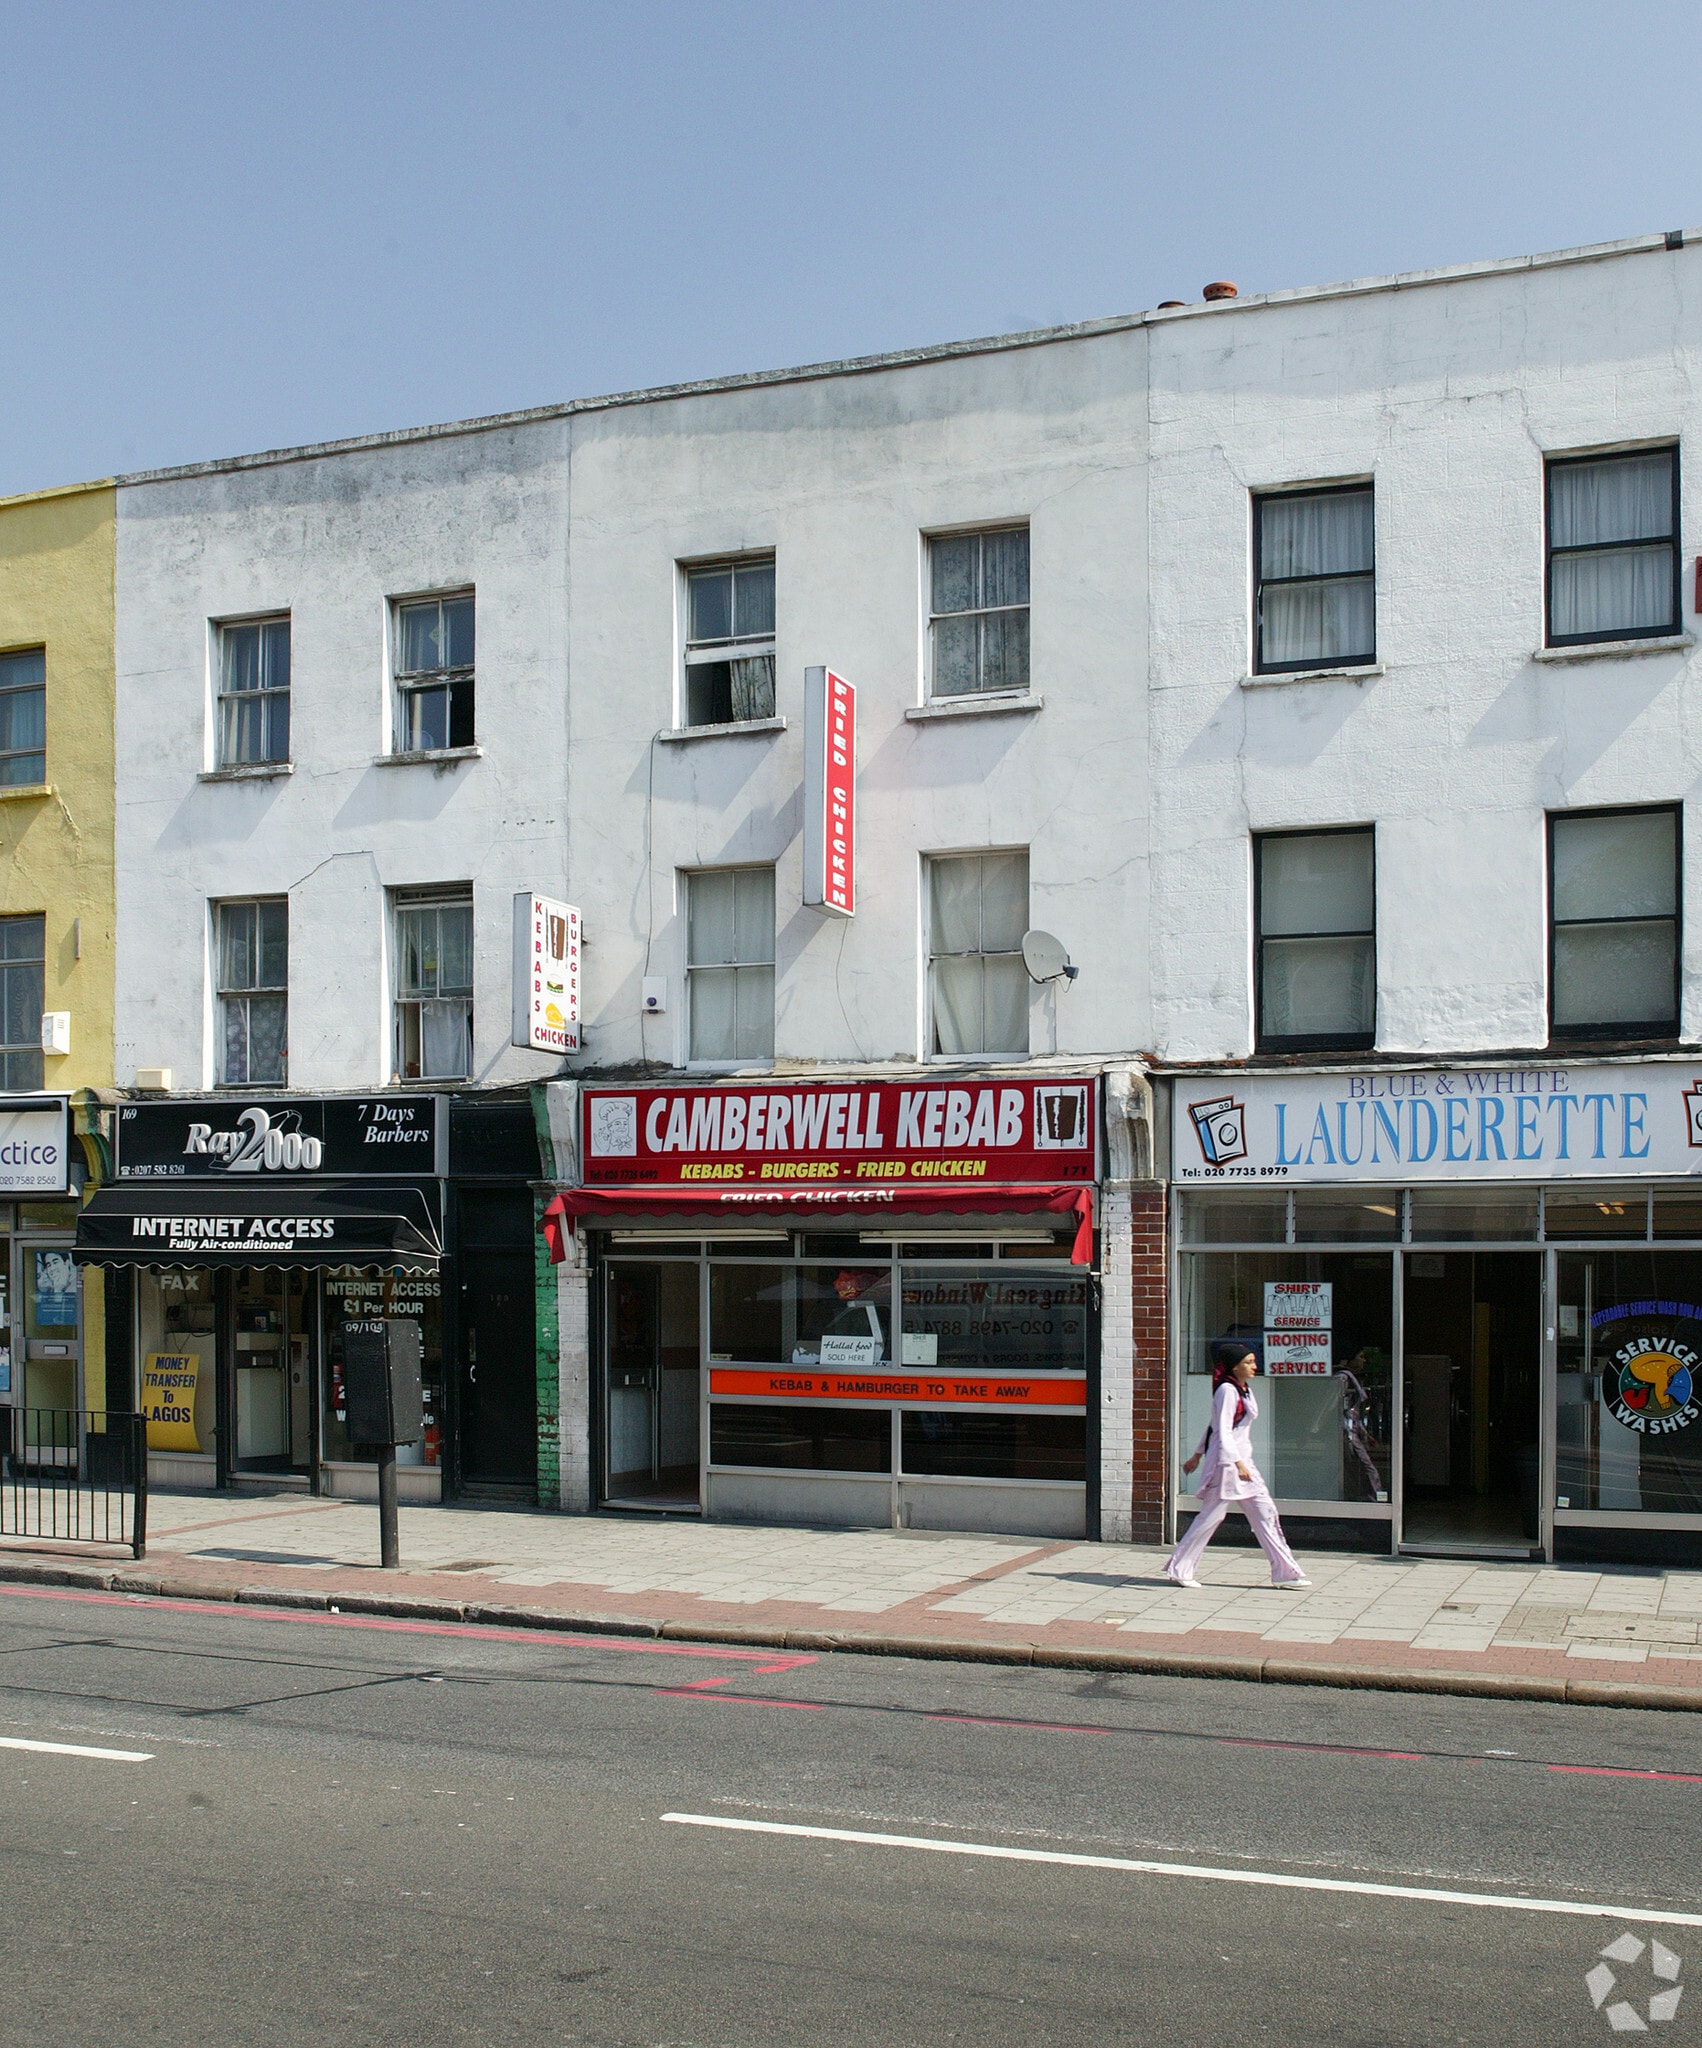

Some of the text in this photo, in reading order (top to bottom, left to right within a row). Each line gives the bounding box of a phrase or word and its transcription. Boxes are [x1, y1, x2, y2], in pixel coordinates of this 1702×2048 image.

[832, 680, 847, 906] FRIED CHICKEN
[534, 903, 543, 1012] KEBABS
[570, 913, 578, 1021] BURGERS
[534, 1027, 577, 1049] CHICKEN
[1348, 1070, 1569, 1098] BLUE & WHITE
[121, 1108, 138, 1120] 169
[358, 1104, 415, 1126] 7 Days
[645, 1088, 1025, 1153] CAMBERWELL KEBAB
[364, 1125, 430, 1143] Barbers
[1275, 1093, 1651, 1166] LAUNDERETTE
[680, 1163, 744, 1179] KEBABS
[760, 1162, 840, 1178] BURGERS
[856, 1161, 906, 1177] FRIED
[911, 1160, 987, 1177] CHICKEN
[1182, 1166, 1288, 1177] Tel: 020 7735 8979
[132, 1218, 335, 1238] INTERNET ACCESS
[169, 1238, 294, 1250] Fully Air-conditioned
[160, 1275, 200, 1291] FAX
[326, 1282, 441, 1296] INTERNET ACCESS
[1274, 1284, 1322, 1294] SHIRT
[344, 1300, 424, 1314] £1 Per HOUR
[1274, 1317, 1320, 1326] SERVICE
[1267, 1334, 1328, 1346] IRONING
[827, 1353, 866, 1362] SOLD HERE
[1616, 1337, 1699, 1366] SERVICE
[156, 1356, 190, 1370] MONEY
[1270, 1362, 1326, 1374] SERVICE
[146, 1374, 196, 1388] TRANSFER
[770, 1380, 1030, 1398] KEBAB & HAMBURGER TO TAKE AWAY
[162, 1390, 174, 1403] To
[144, 1406, 190, 1422] LAGOS
[1616, 1403, 1699, 1435] WASHES
